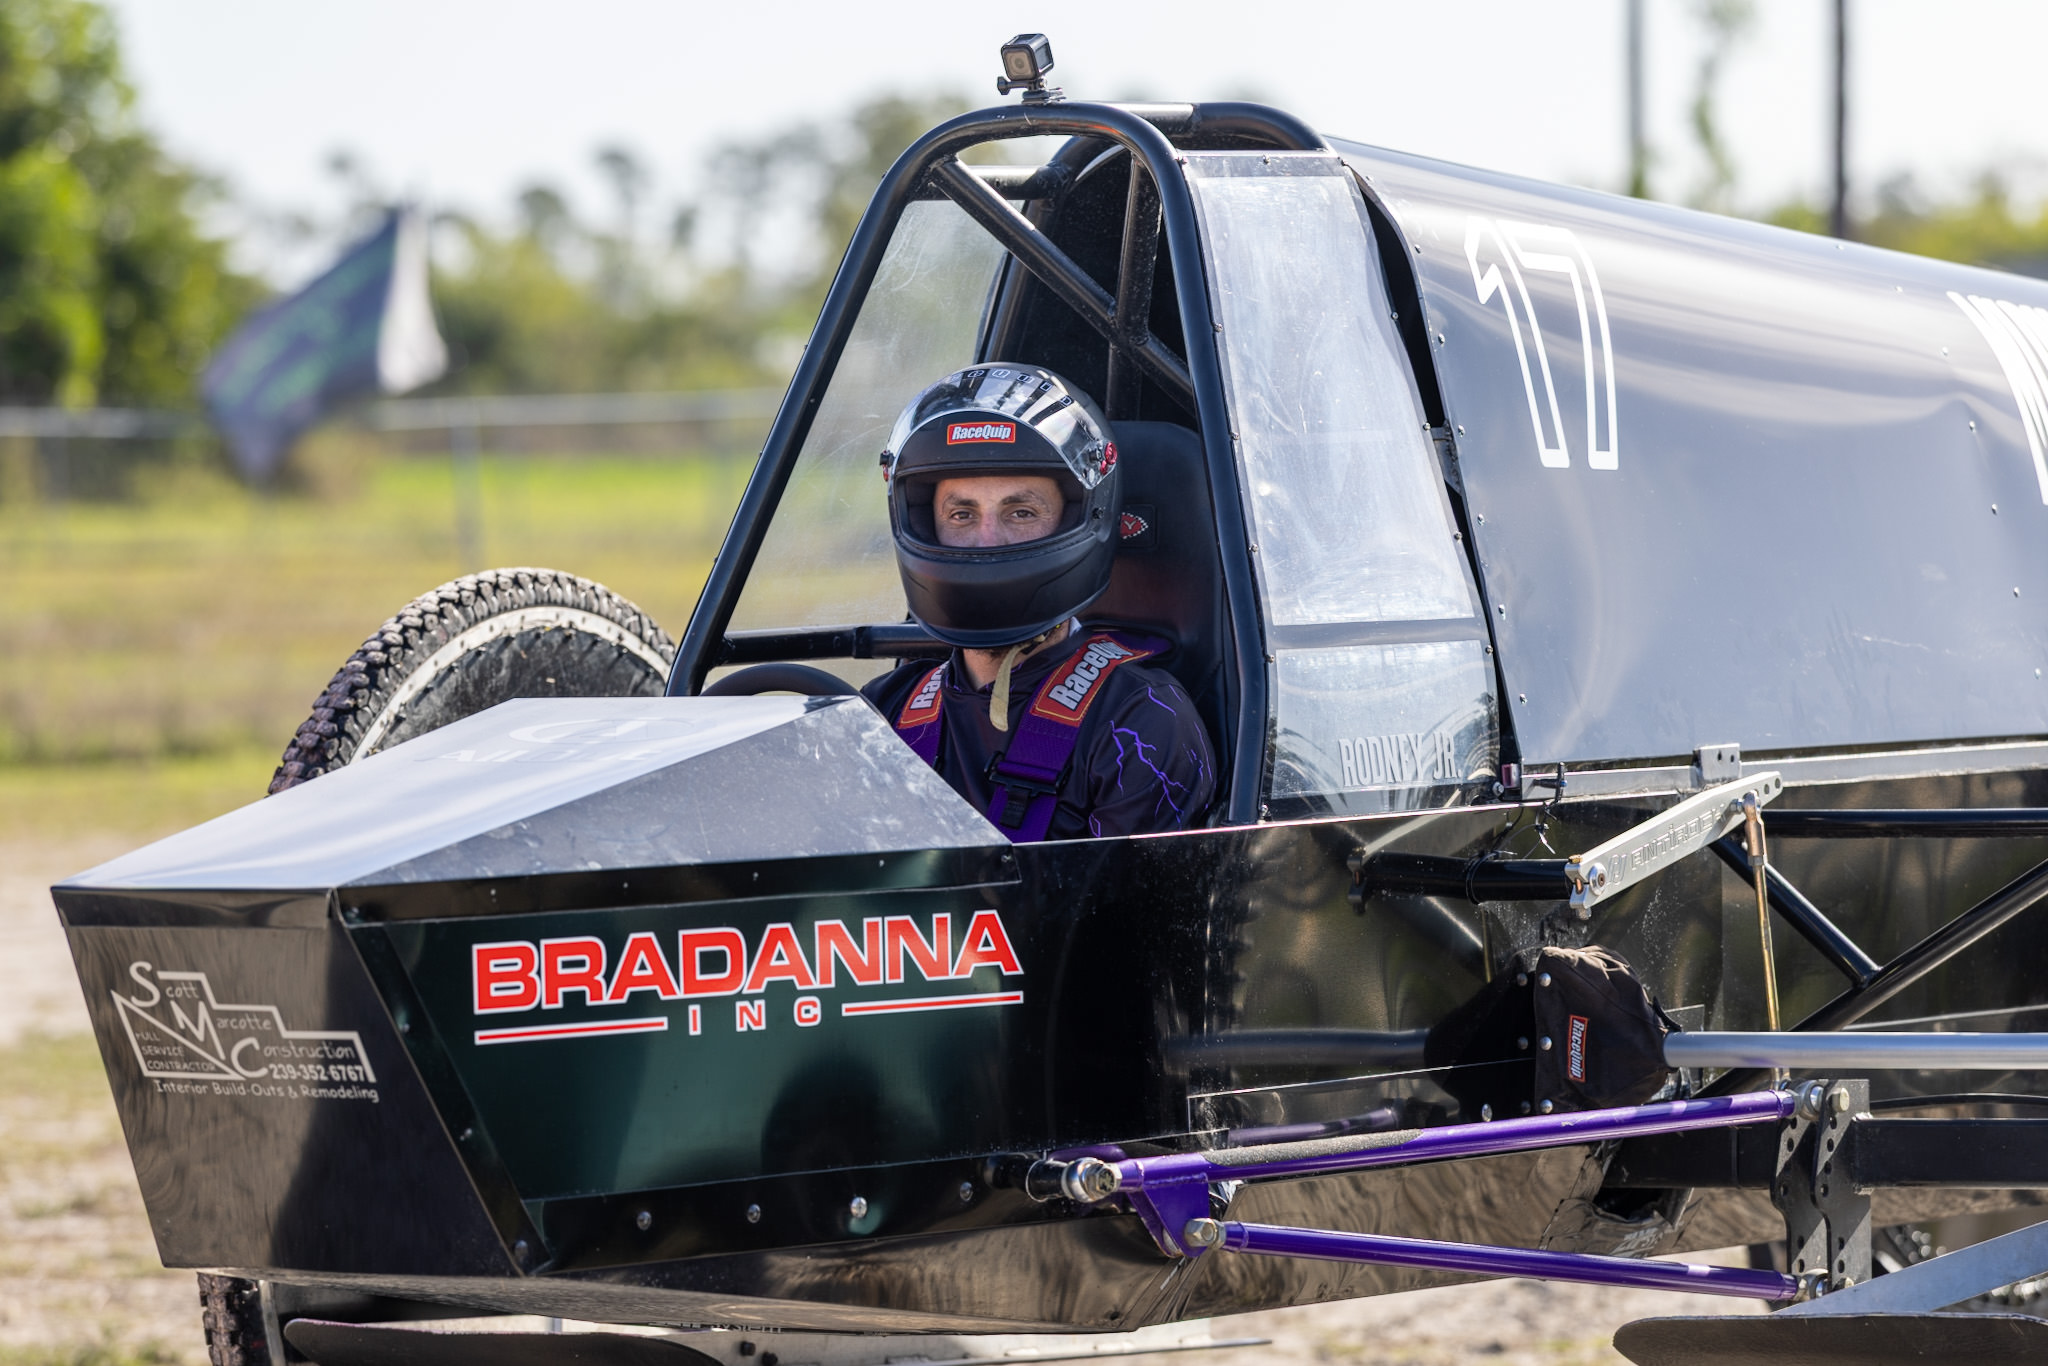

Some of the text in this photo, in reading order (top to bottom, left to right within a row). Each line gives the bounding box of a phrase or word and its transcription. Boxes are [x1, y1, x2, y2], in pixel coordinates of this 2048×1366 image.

[1464, 215, 1619, 470] 17
[952, 424, 1012, 440] RaceQuip
[1338, 733, 1425, 787] RODNEY
[472, 909, 1025, 1015] BRADANNA
[129, 961, 200, 1008] Scott
[169, 1000, 272, 1060] Marcotte
[688, 996, 822, 1036] INC
[142, 1045, 184, 1057] SERVICE
[147, 1060, 216, 1072] CONTRACTOR
[231, 1037, 355, 1078] Construction
[1570, 1019, 1585, 1079] RaceQuip
[153, 1079, 208, 1094] Interior
[300, 1084, 379, 1103] Remodeling
[269, 1063, 365, 1082] 239-352-6767
